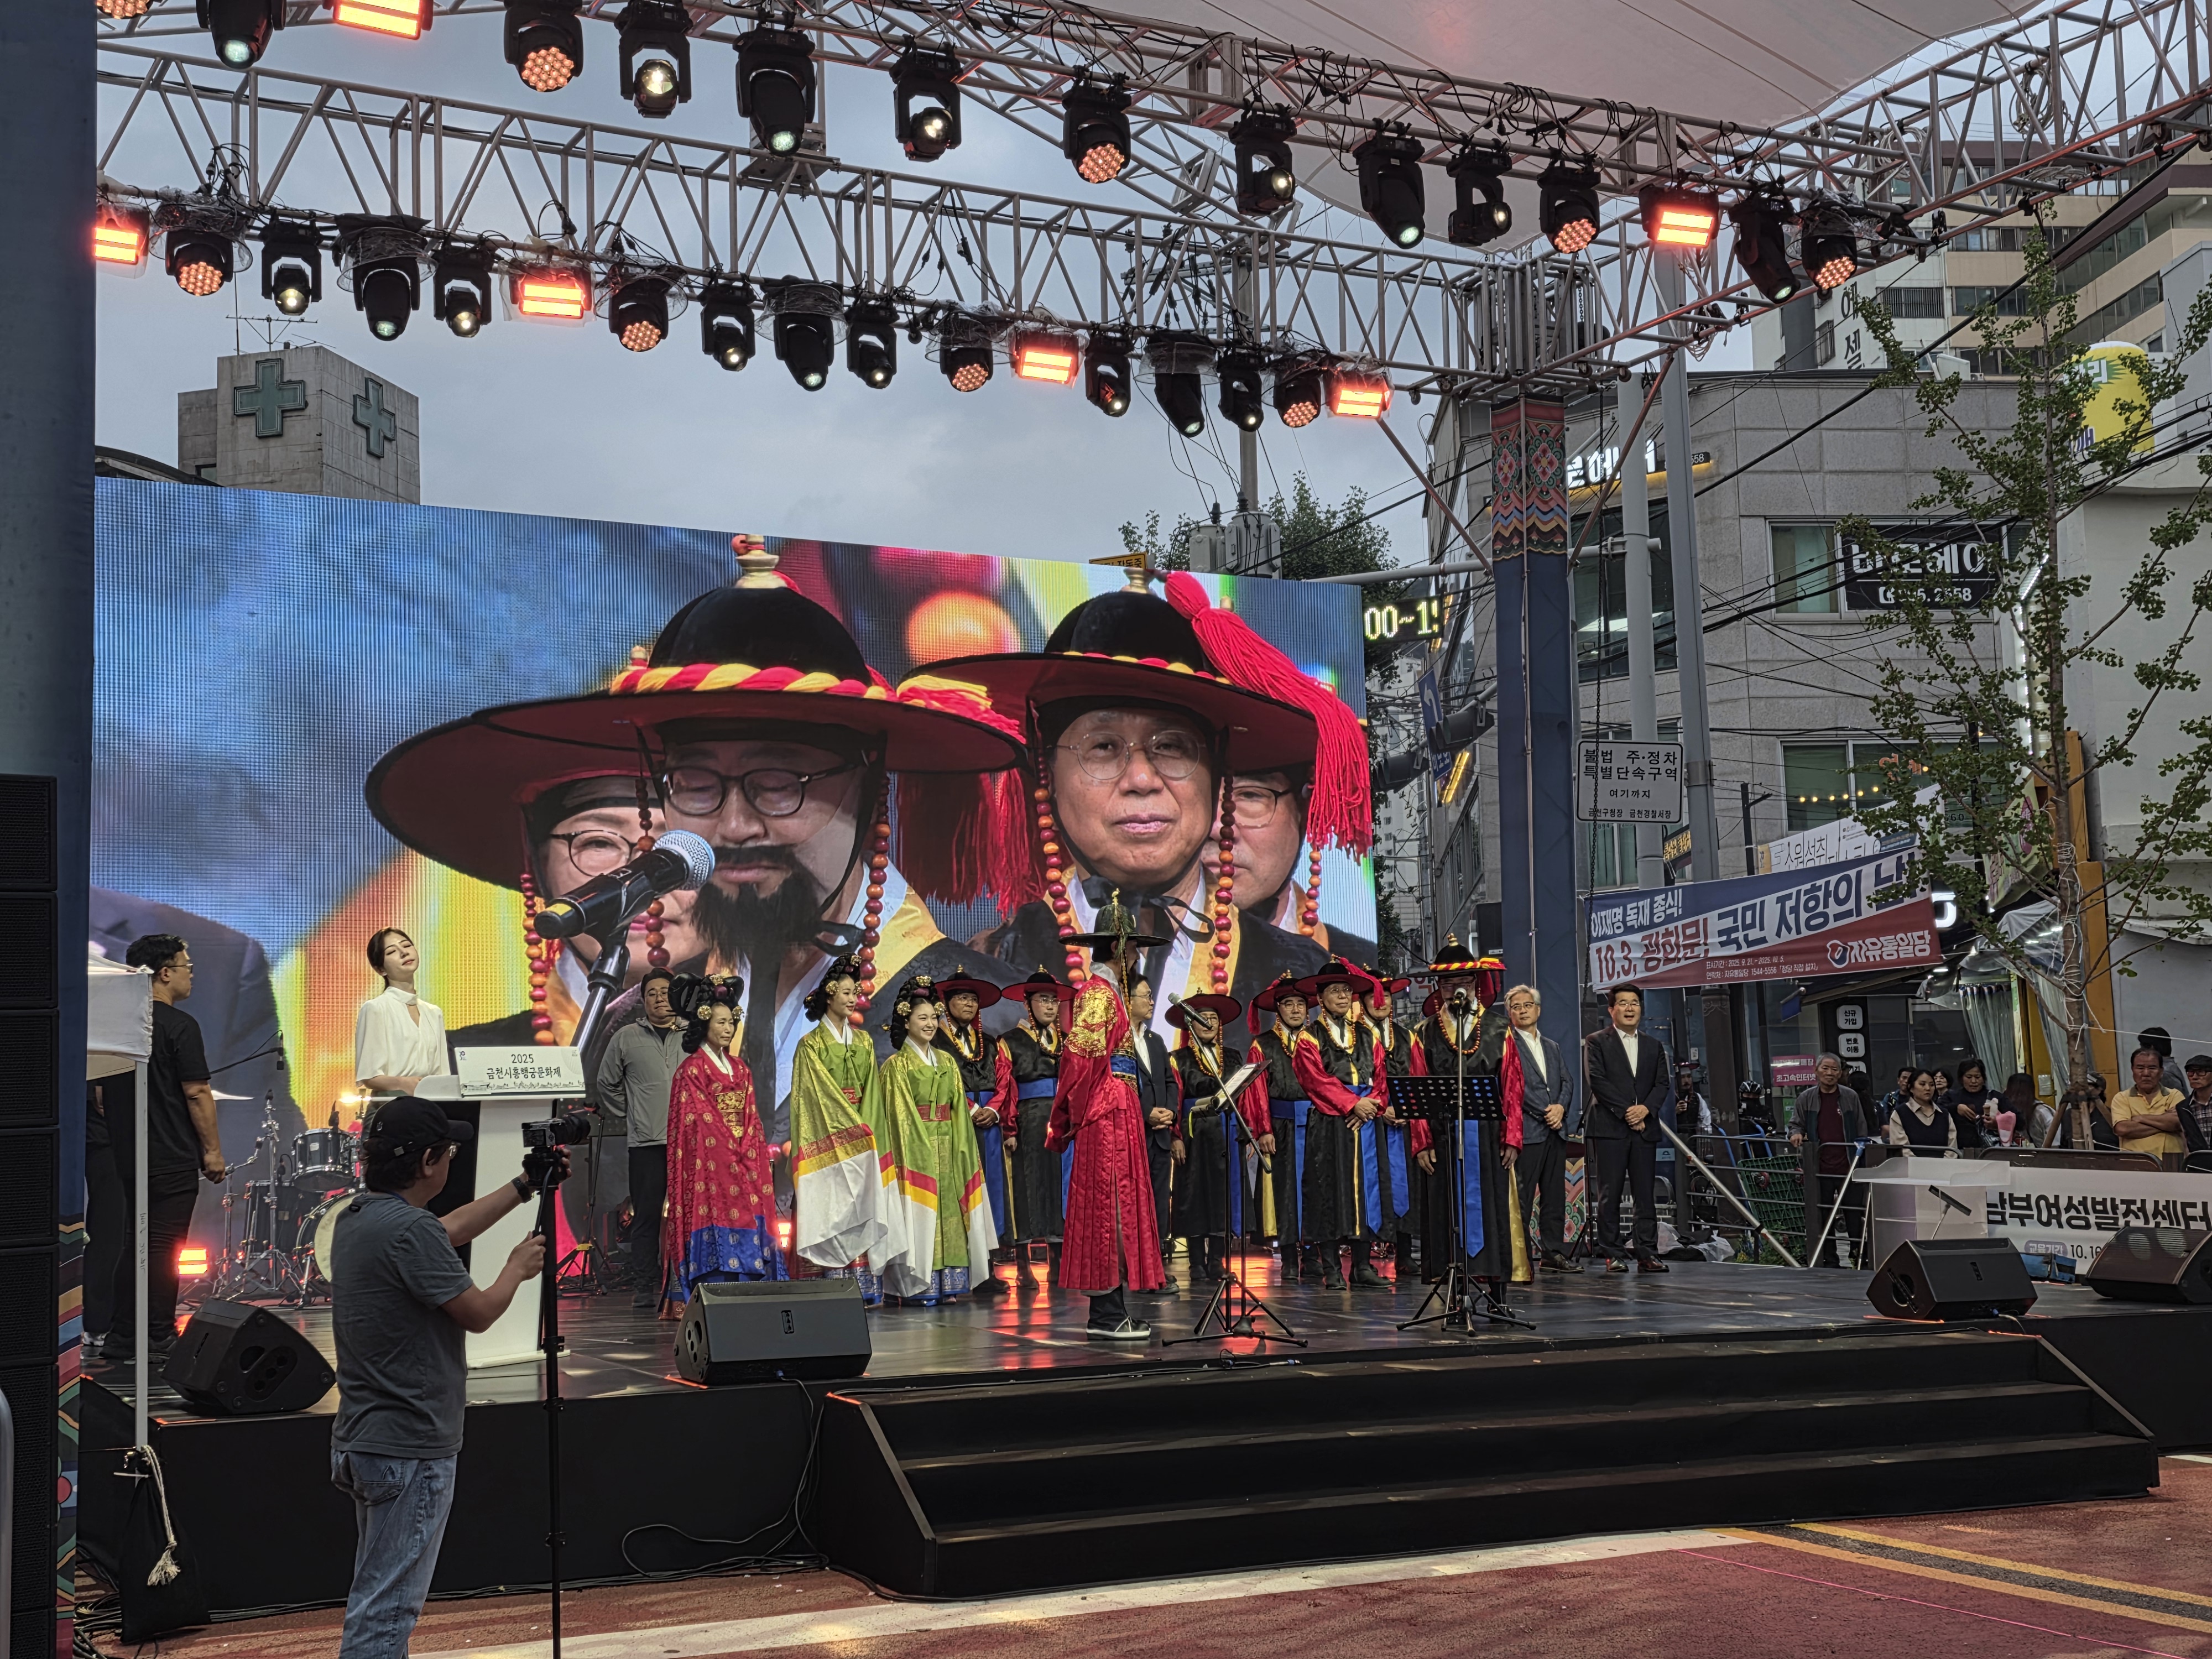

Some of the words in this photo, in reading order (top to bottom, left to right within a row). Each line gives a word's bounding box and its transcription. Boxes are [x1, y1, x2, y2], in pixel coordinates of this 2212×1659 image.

[1584, 749, 1613, 764] 불법
[1626, 750, 1677, 765] 주·정차
[1583, 765, 1677, 781] 특별단속구역
[1609, 789, 1650, 799] 여기까지
[1588, 808, 1623, 818] 금천구청장
[1629, 809, 1671, 819] 금천경찰서장
[1590, 906, 1624, 937] 이재명
[1626, 898, 1650, 929] 독재
[1653, 889, 1682, 924] 종식!
[1595, 940, 1637, 983] 10.3,
[1641, 917, 1709, 973] 광화문!
[1717, 899, 1768, 952] 국민
[1775, 869, 1863, 939] 저항의
[1847, 930, 1931, 963] 자유통일당
[1725, 968, 1749, 978] 자유통일당
[511, 1053, 534, 1063] 2025
[486, 1066, 561, 1079] 금천시흥행궁문화제
[1776, 1073, 1816, 1082] 초고속인터넷
